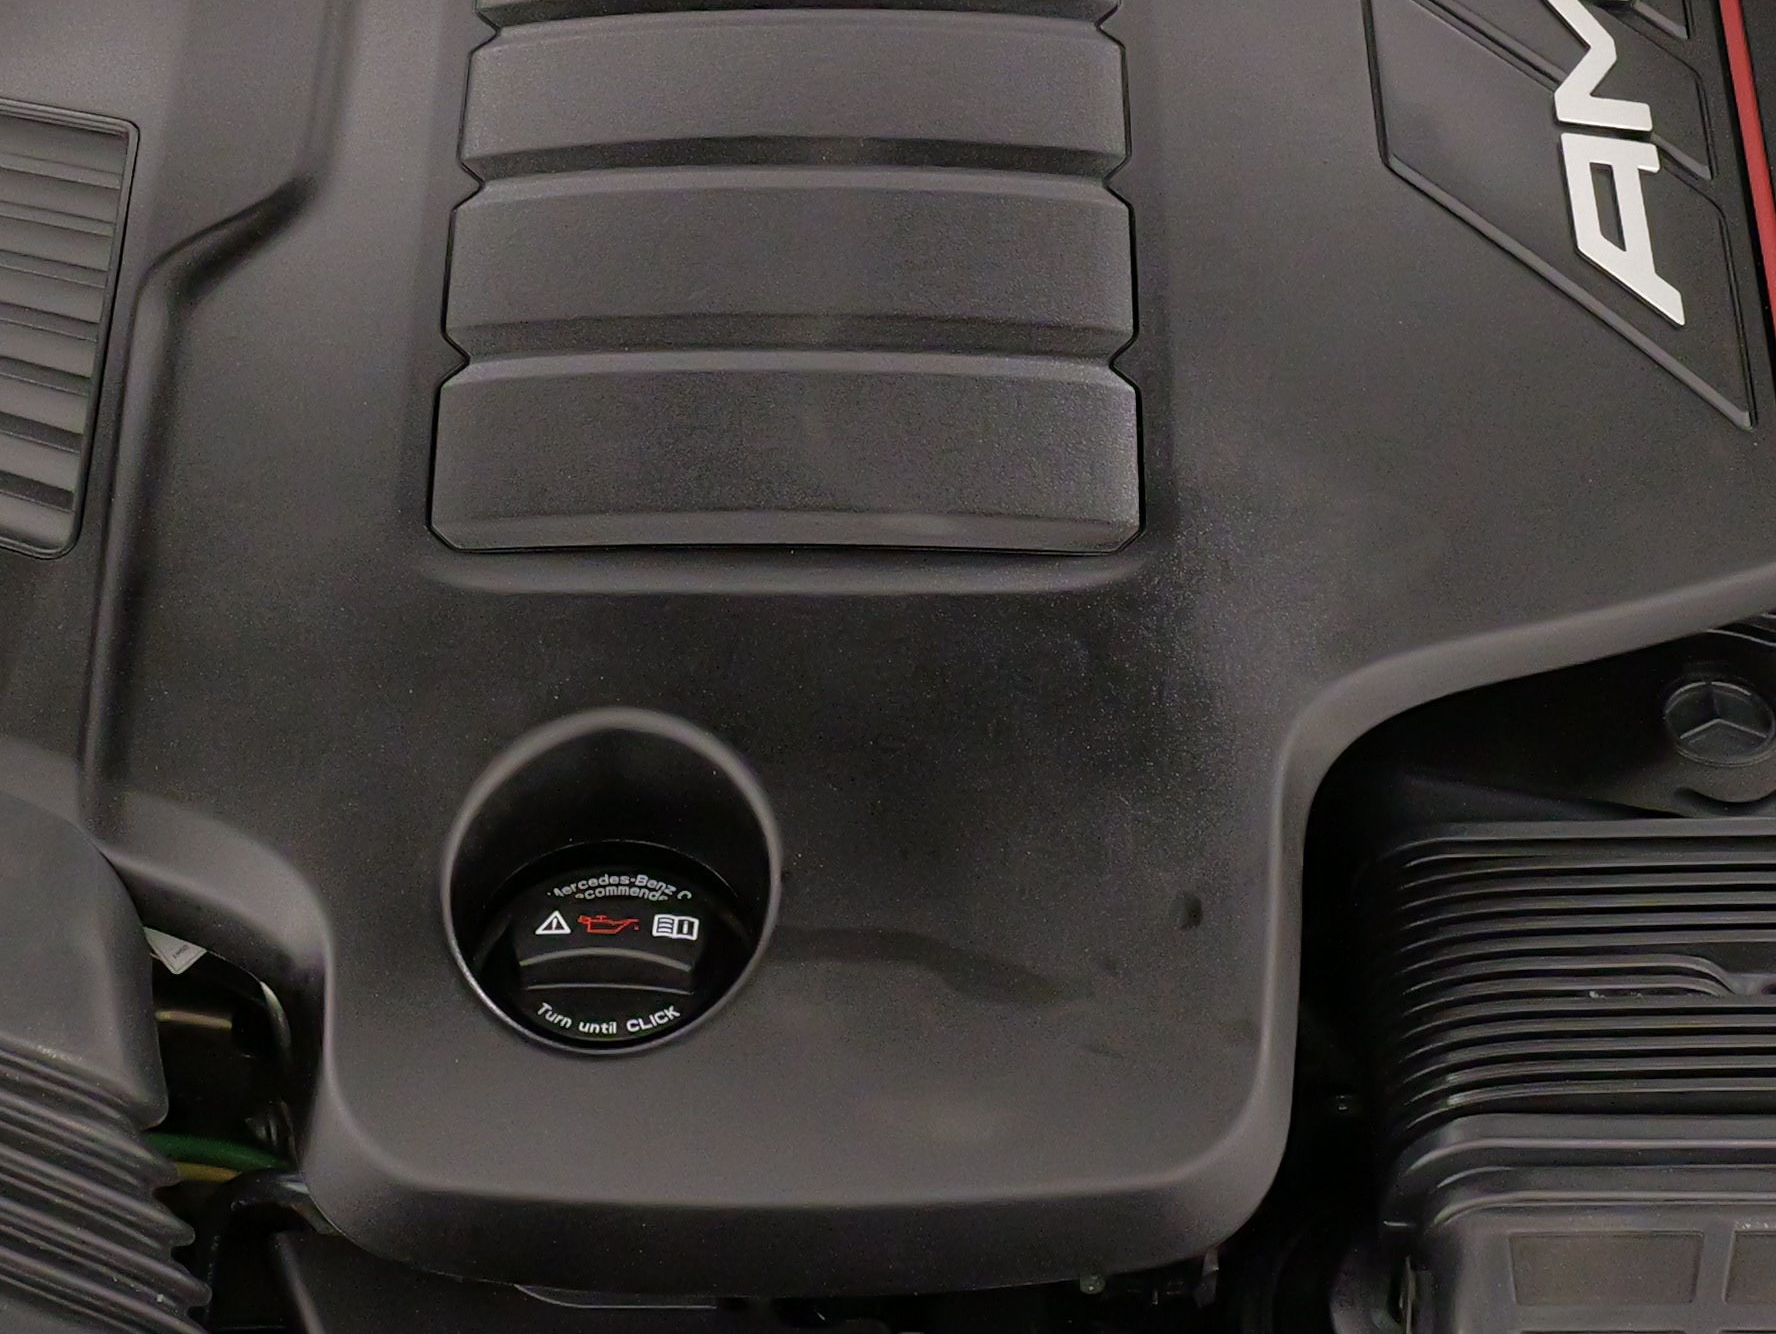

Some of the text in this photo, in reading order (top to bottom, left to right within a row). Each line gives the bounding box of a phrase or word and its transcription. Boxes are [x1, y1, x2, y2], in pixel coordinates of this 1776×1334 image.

[536, 1002, 681, 1035] Turn until CLICK
